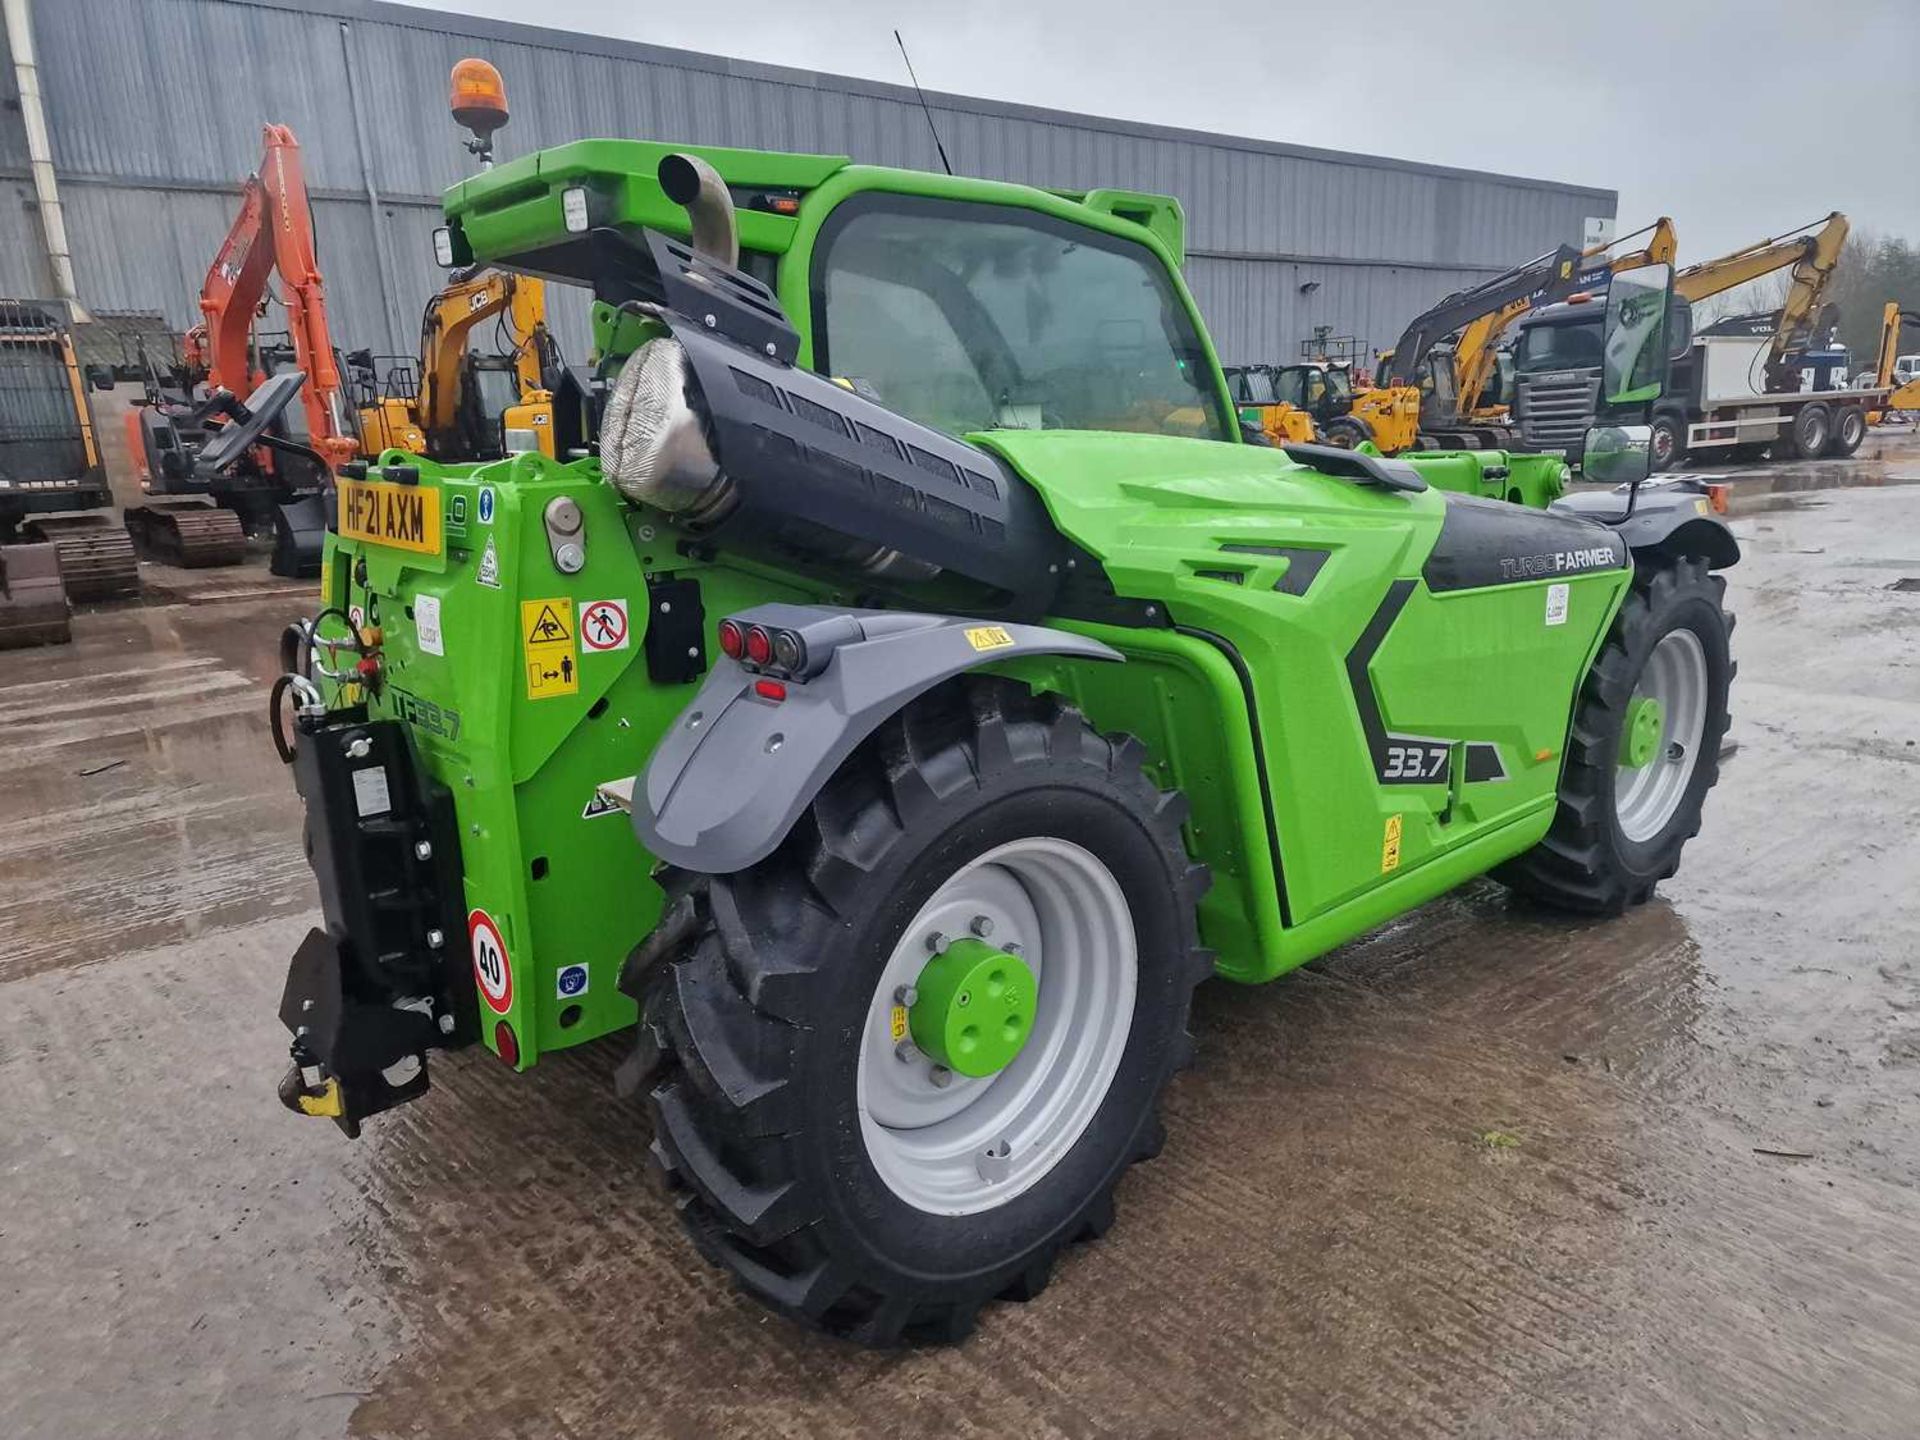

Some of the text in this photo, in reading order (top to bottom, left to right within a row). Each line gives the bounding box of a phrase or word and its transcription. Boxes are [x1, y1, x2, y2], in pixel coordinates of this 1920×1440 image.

[471, 290, 489, 312] JCB
[346, 487, 380, 537] HF21
[386, 491, 424, 544] AXM
[1384, 747, 1448, 778] 33.7
[480, 940, 501, 986] 40
